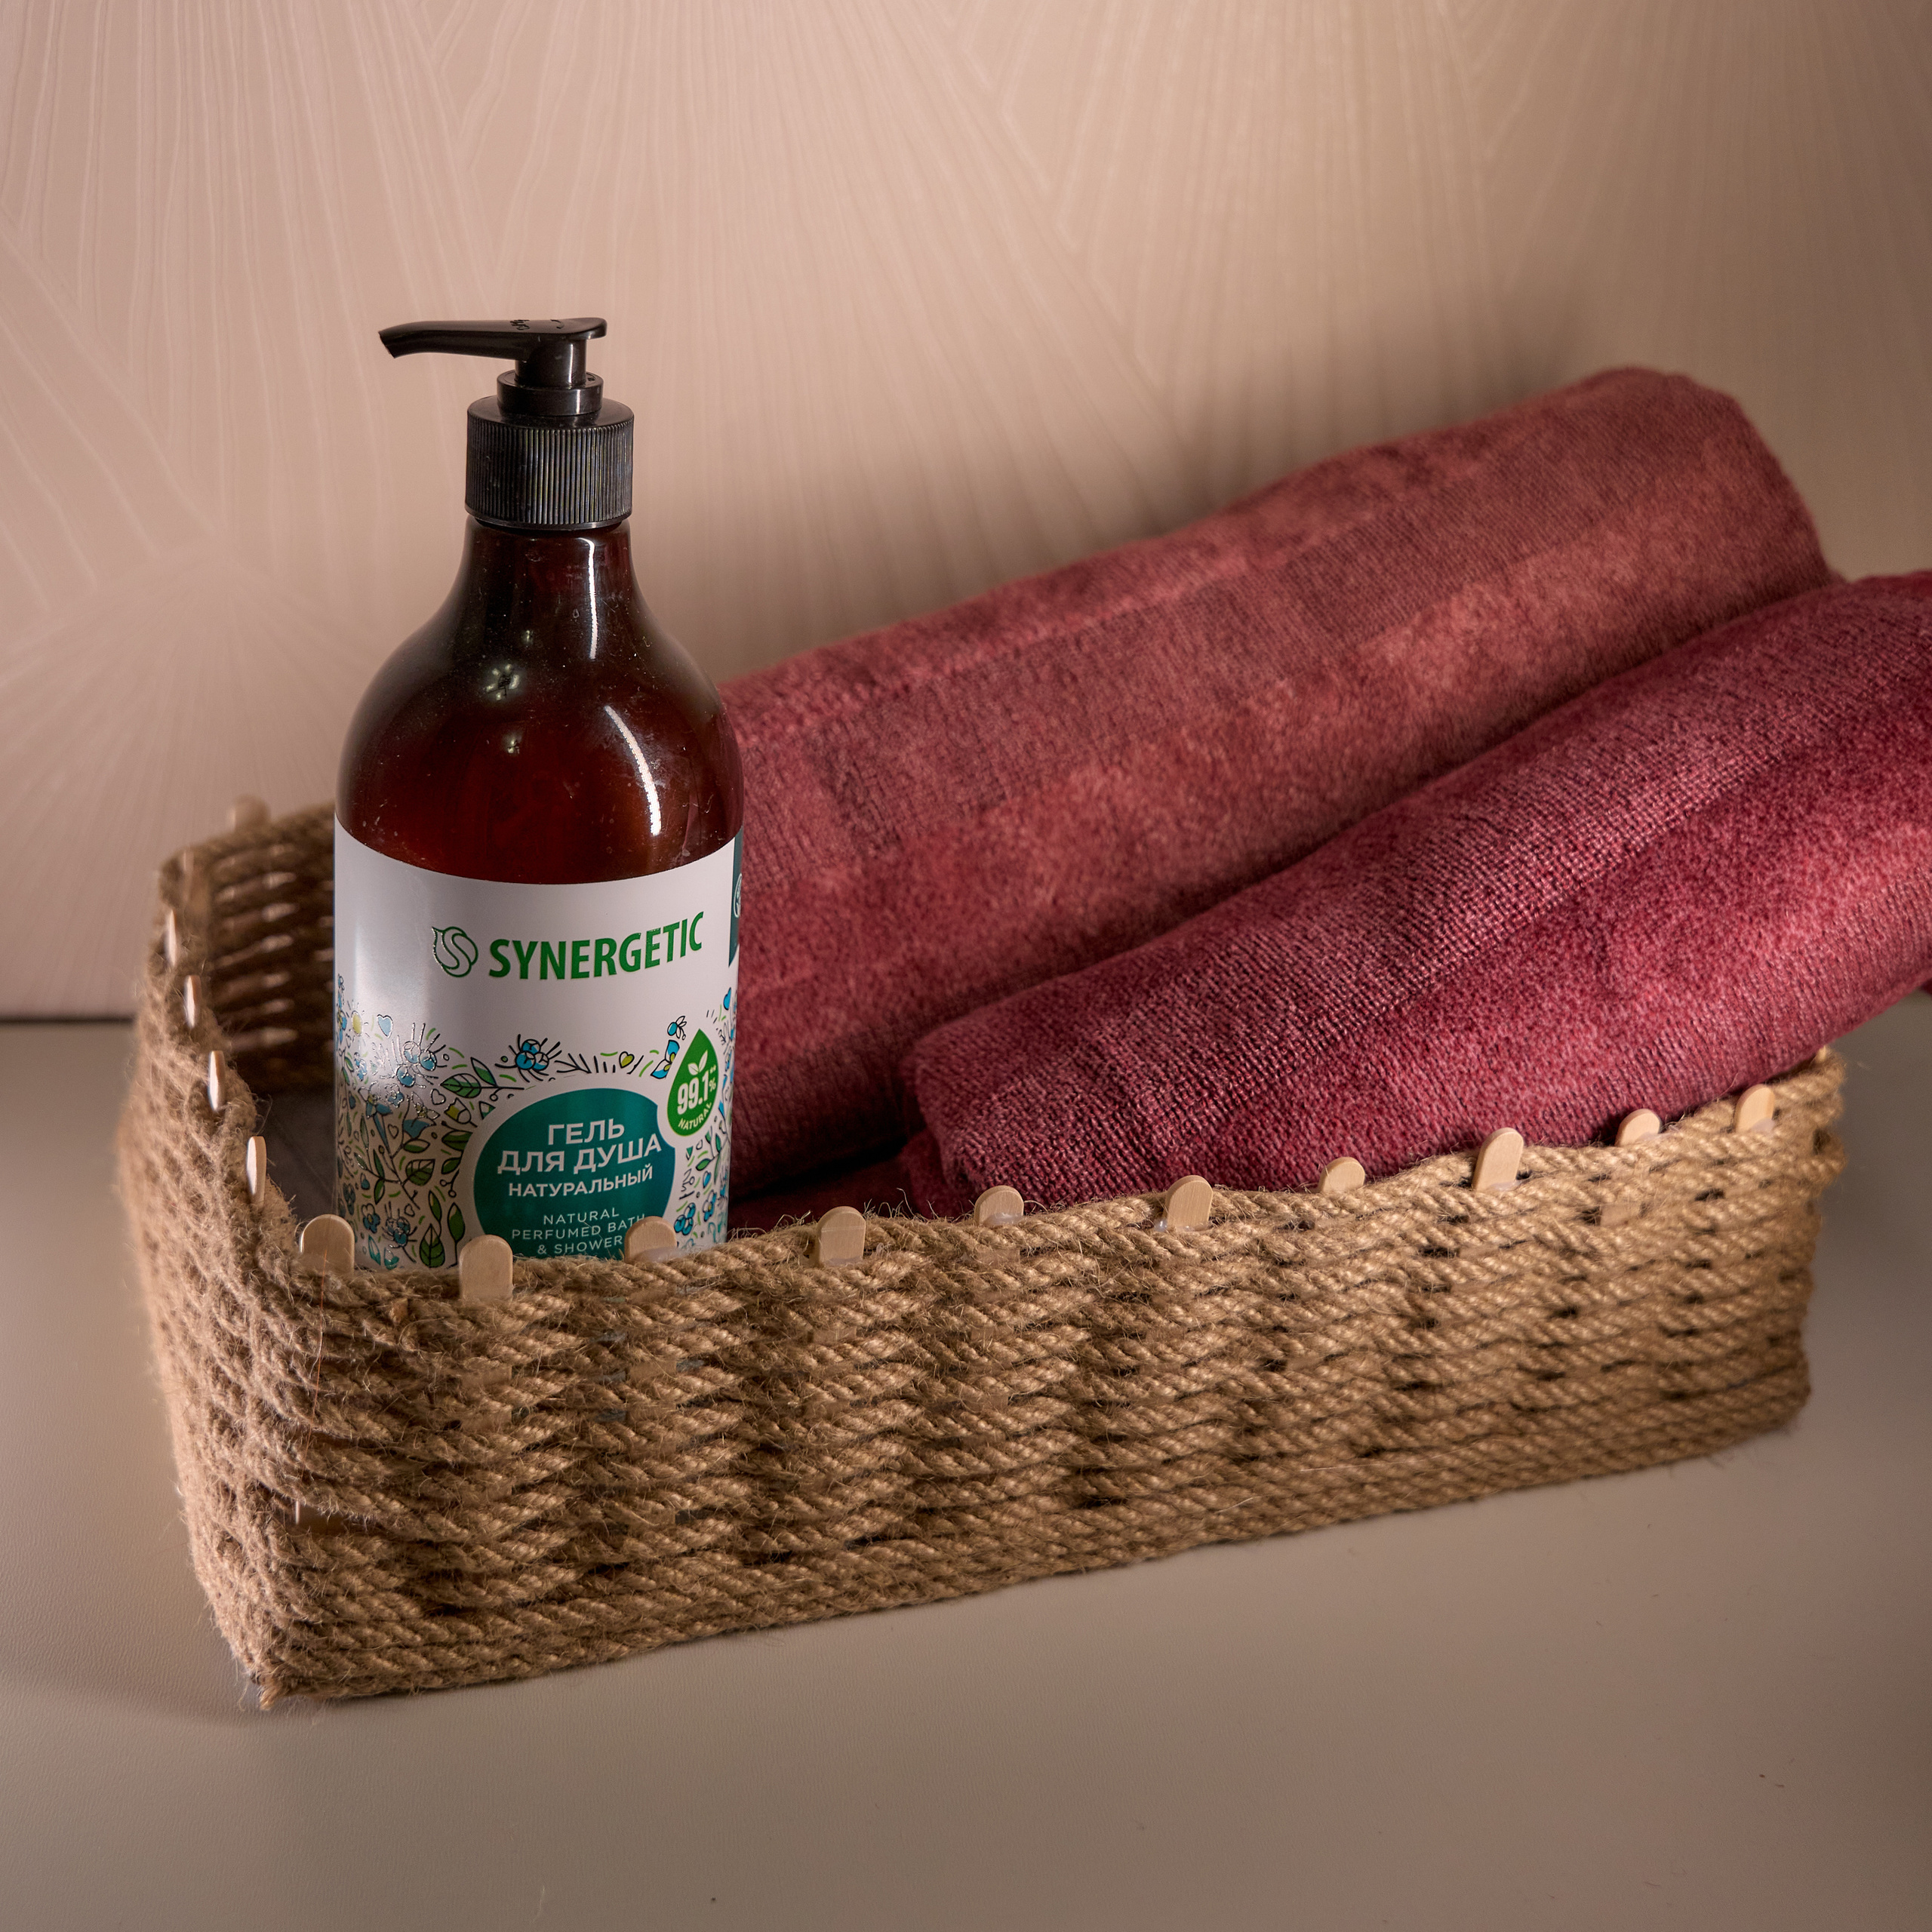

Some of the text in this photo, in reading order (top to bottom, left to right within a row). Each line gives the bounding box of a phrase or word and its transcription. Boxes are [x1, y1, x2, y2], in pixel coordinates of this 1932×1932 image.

[488, 911, 704, 980] SYNERGETIC
[678, 1102, 712, 1131] NATURAL
[548, 1118, 625, 1146] ГЕЛЬ
[497, 1133, 662, 1175] ДЛЯ ДУША
[509, 1163, 653, 1197] НАТУРАЛЬНЫЙ
[543, 1208, 620, 1225] NATURAL
[512, 1225, 601, 1240] PERFUMED
[537, 1235, 623, 1254] & SHOWER
